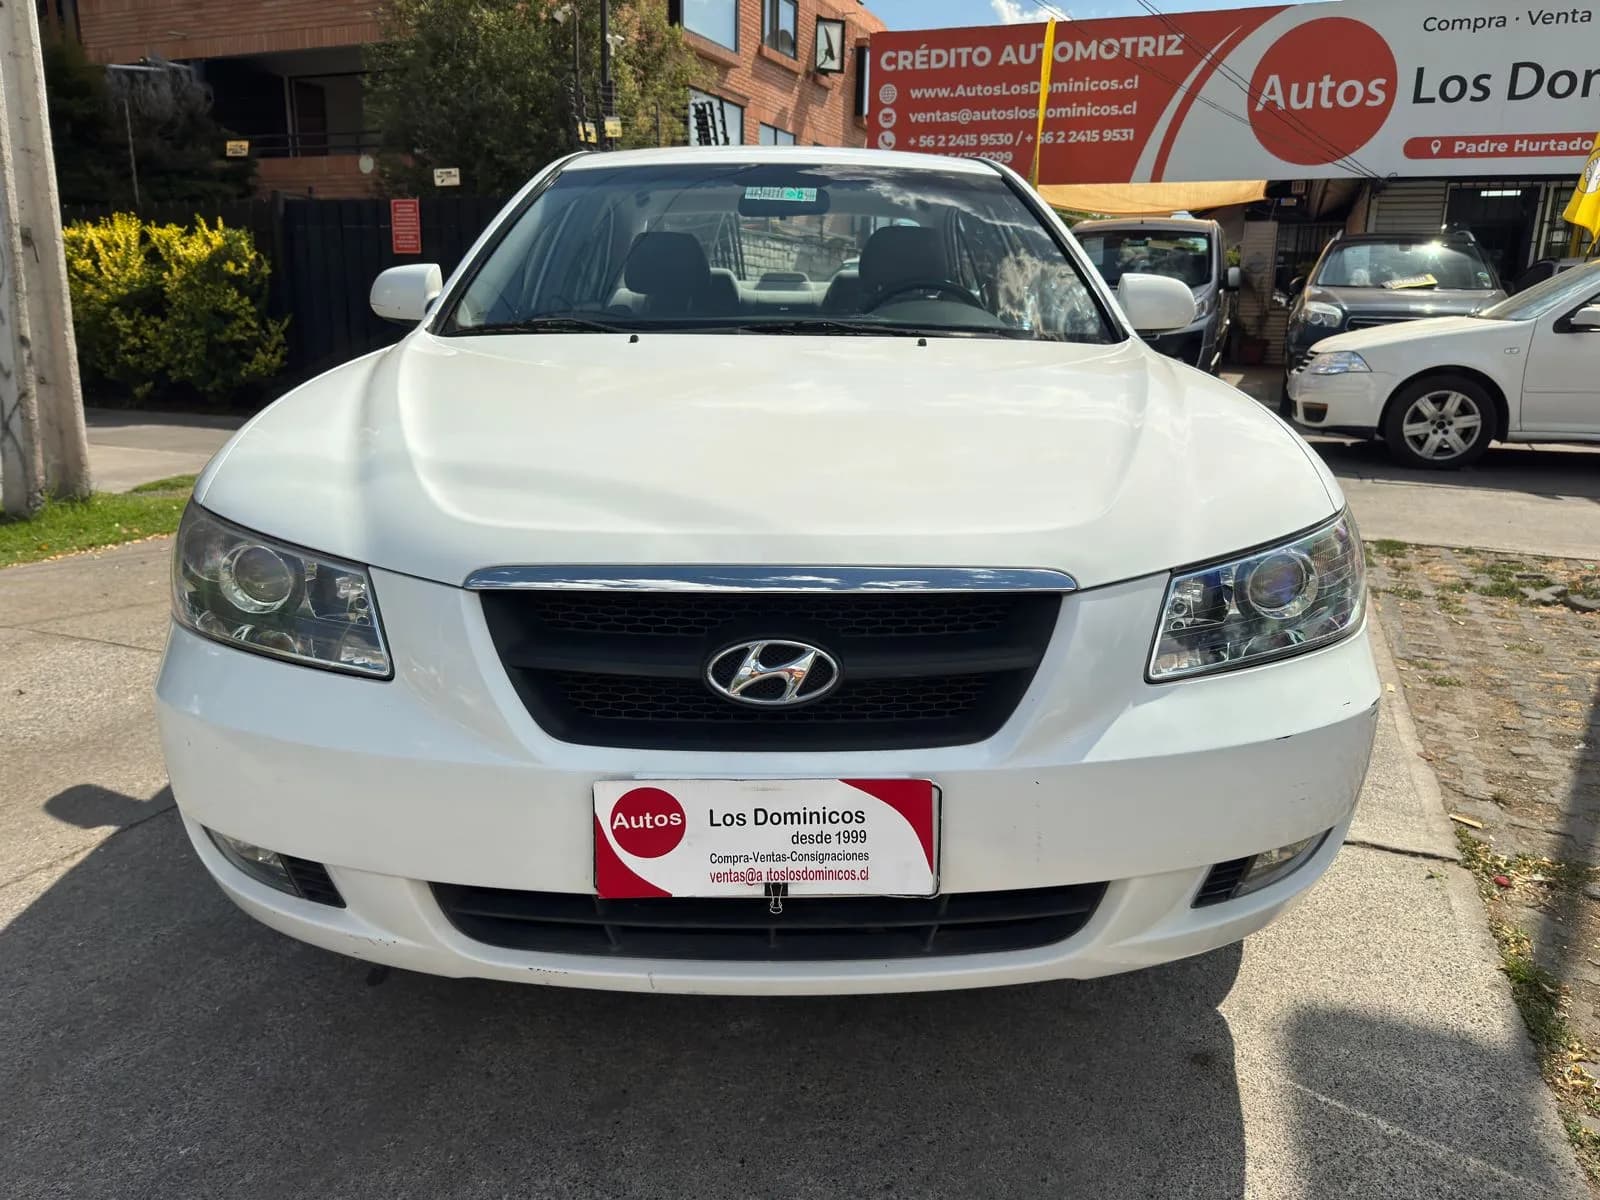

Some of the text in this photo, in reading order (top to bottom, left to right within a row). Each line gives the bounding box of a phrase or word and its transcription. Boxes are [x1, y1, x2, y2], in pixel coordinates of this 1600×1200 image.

[1423, 9, 1592, 33] Compra Venta
[880, 34, 1185, 71] CRÉDITO AUOMOTRIZ
[910, 75, 1139, 99] www.AutosLosDminicos.cl
[1255, 74, 1387, 112] Autos
[1412, 66, 1491, 104] Los
[909, 101, 1137, 124] ventas@autoslosominicos.cl
[918, 135, 935, 147] 56
[937, 135, 946, 147] 2
[948, 134, 977, 147] 2415
[980, 133, 1013, 145] 9530
[1056, 131, 1065, 143] 2
[1068, 130, 1099, 143] 2415
[1102, 128, 1135, 141] 9531
[1454, 137, 1593, 153] Padre Hurtado
[612, 811, 682, 830] Autos
[709, 806, 866, 827] Los Dominicos
[791, 830, 867, 845] desde 1999
